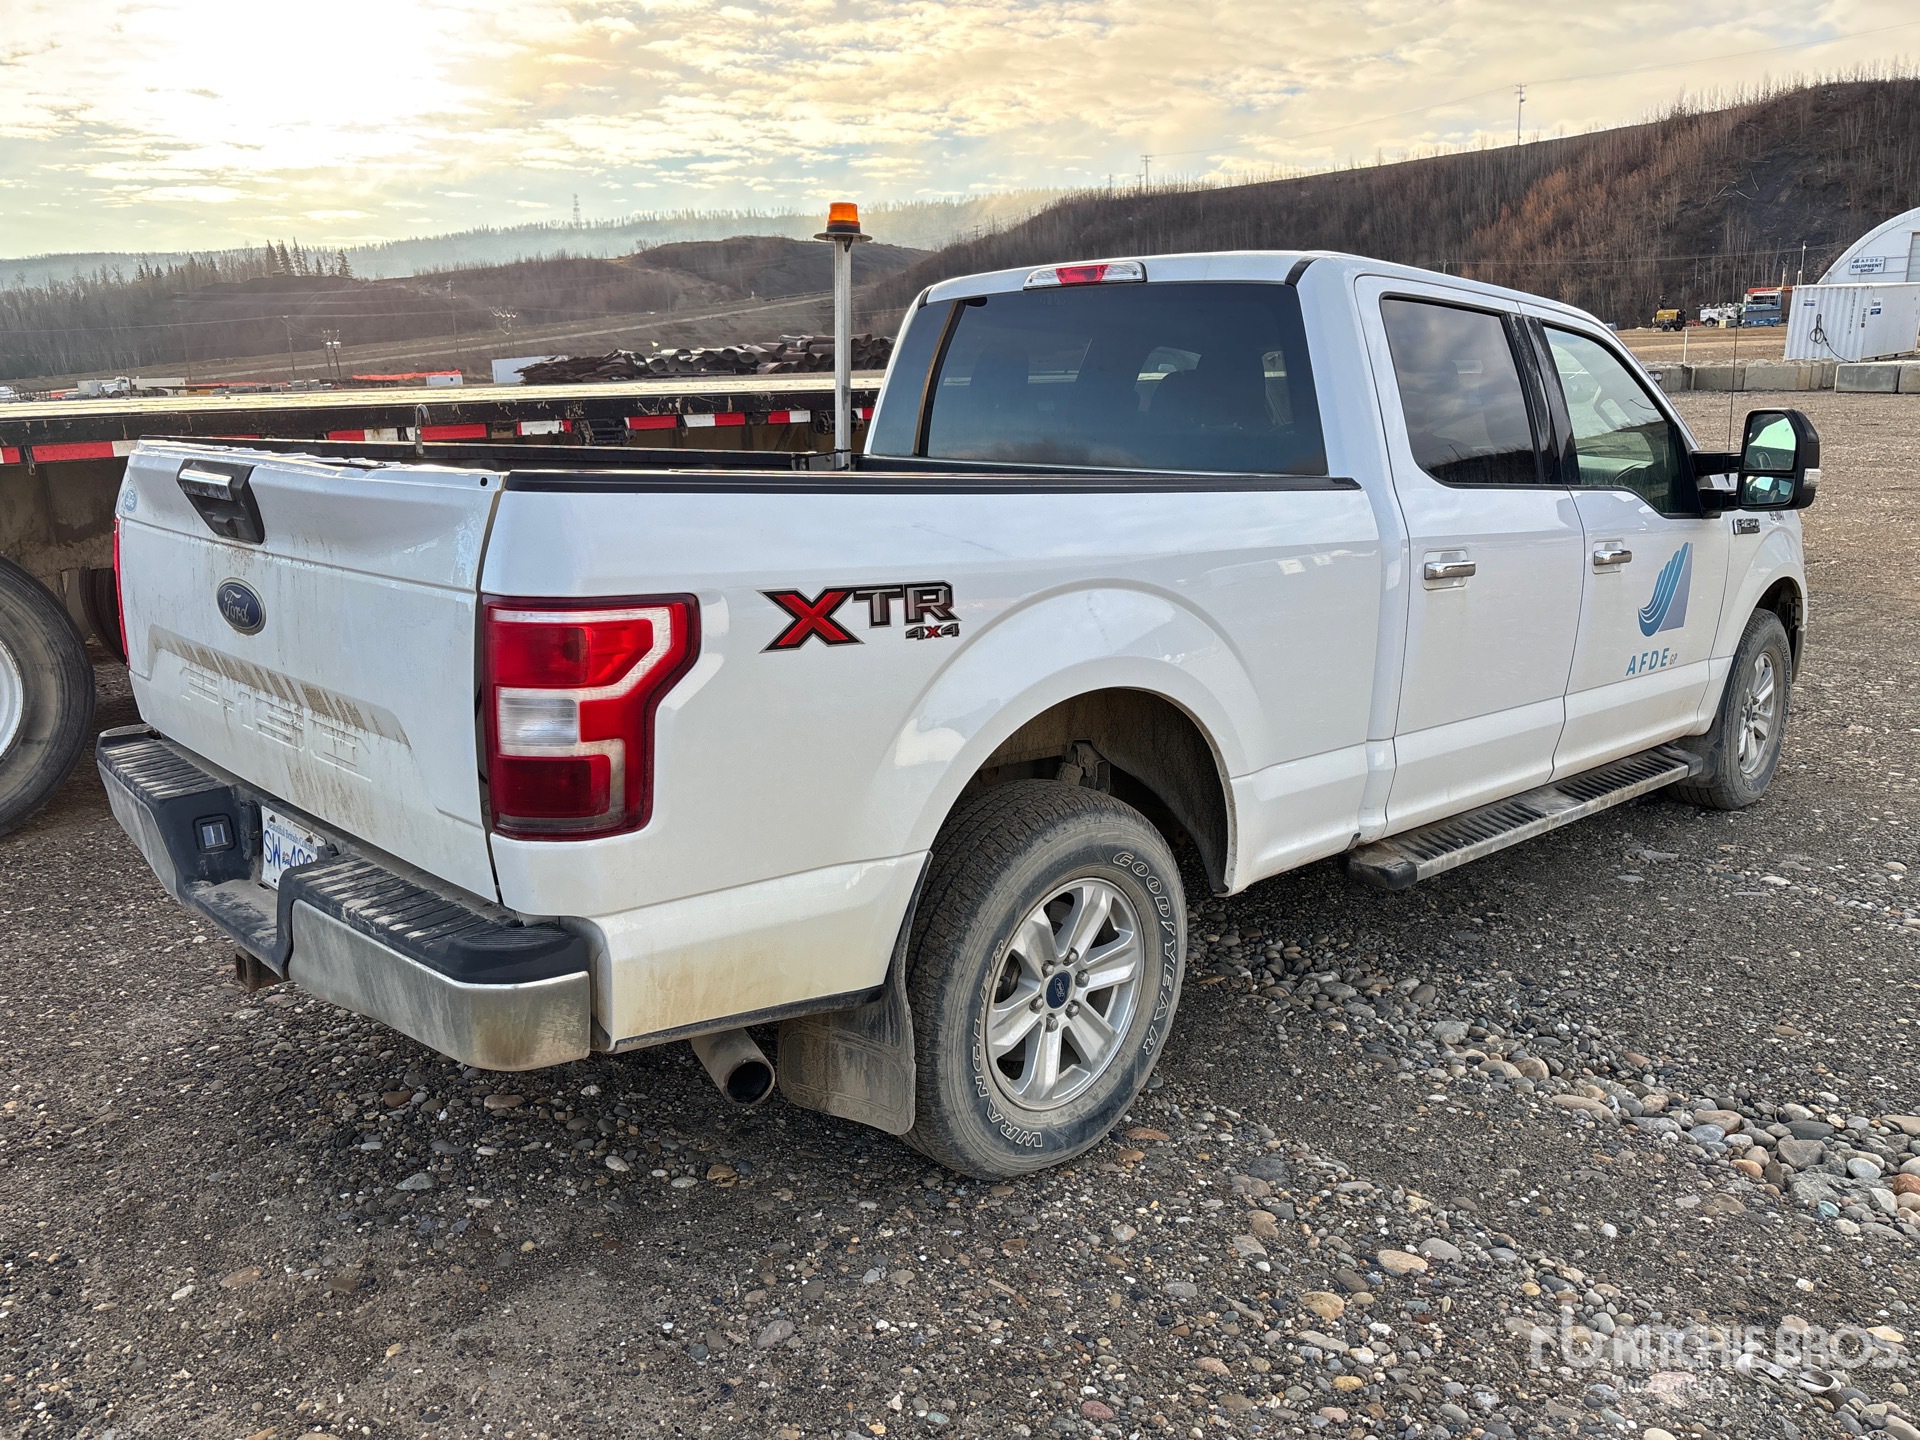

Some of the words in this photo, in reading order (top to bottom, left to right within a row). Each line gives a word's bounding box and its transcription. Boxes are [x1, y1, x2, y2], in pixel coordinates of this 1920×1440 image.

[756, 580, 962, 653] XTR
[1626, 647, 1670, 676] AFDE
[264, 830, 281, 870] SW
[1112, 851, 1176, 1057] GOODYEAR
[971, 939, 1043, 1149] WRANGLER
